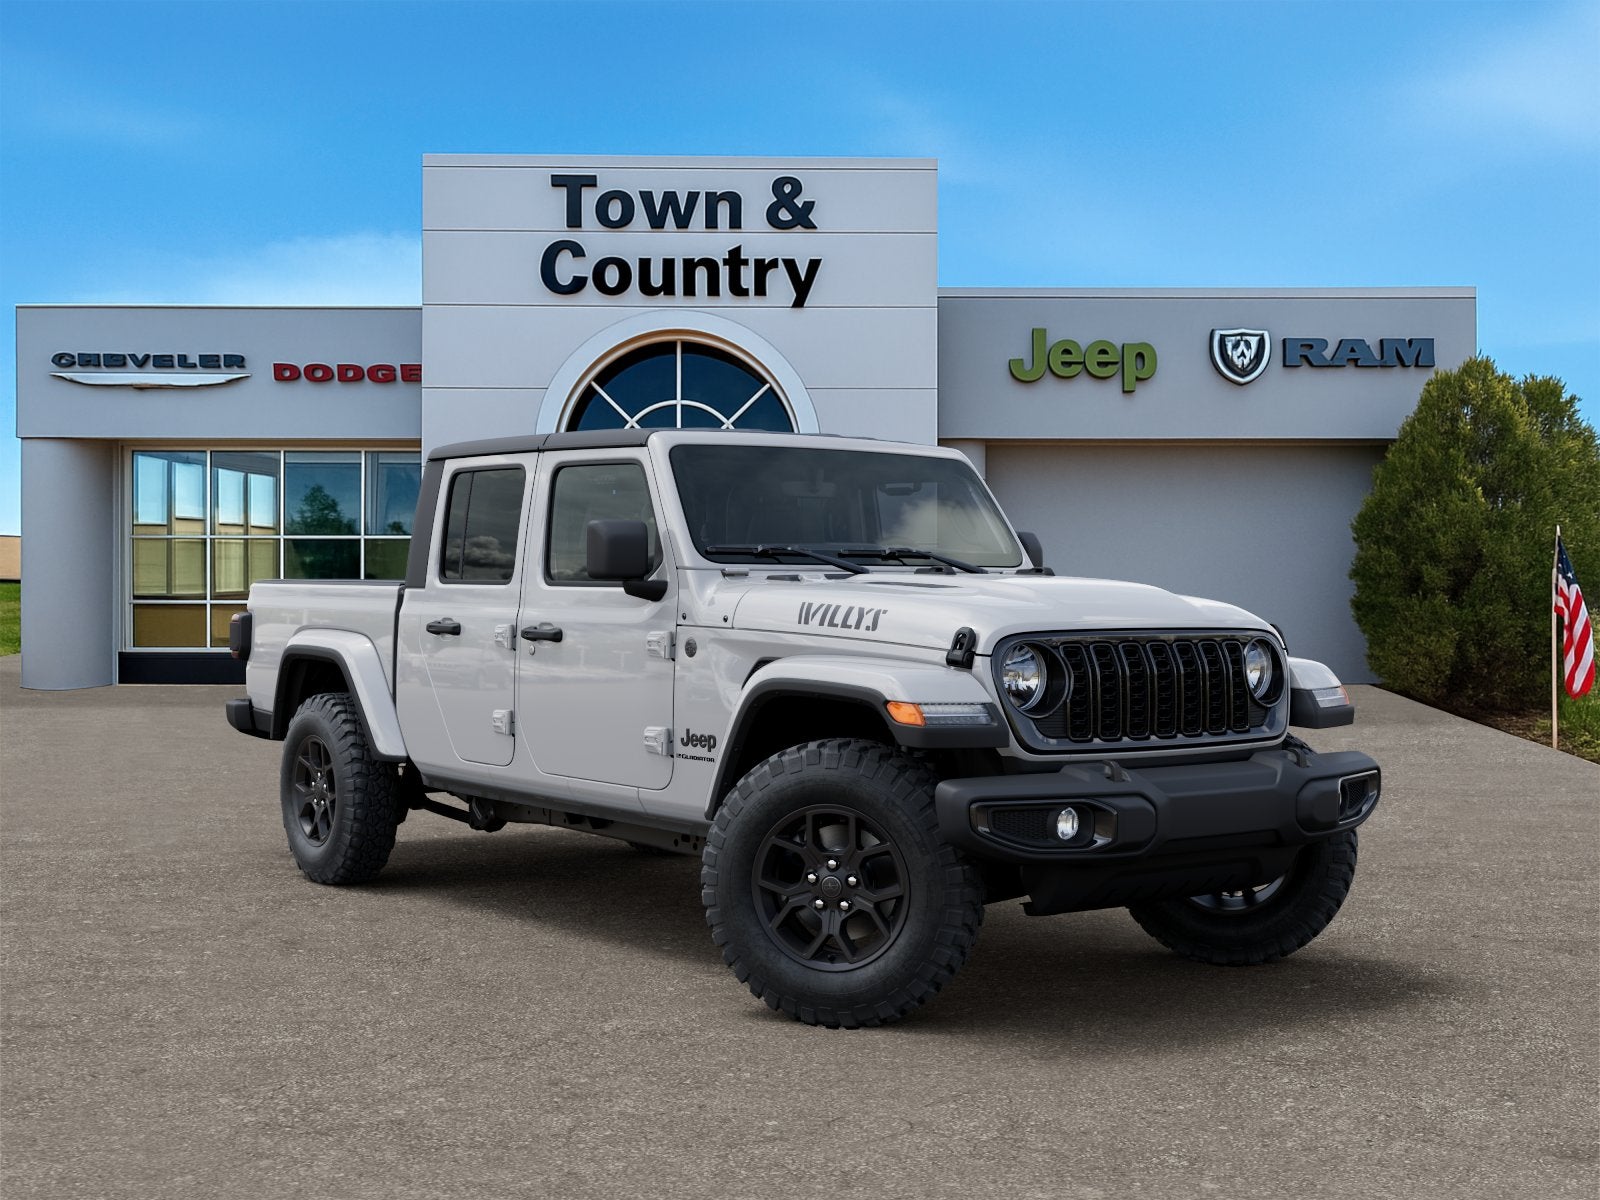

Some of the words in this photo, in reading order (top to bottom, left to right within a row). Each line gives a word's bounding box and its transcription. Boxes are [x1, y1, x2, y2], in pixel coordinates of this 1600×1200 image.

[550, 174, 742, 229] Town
[765, 176, 818, 229] &
[540, 239, 823, 308] Country
[1008, 328, 1158, 393] Jeep
[1282, 337, 1436, 368] RAM
[273, 362, 422, 383] DODGE
[797, 601, 888, 631] WILLYS
[680, 728, 717, 753] Jeep
